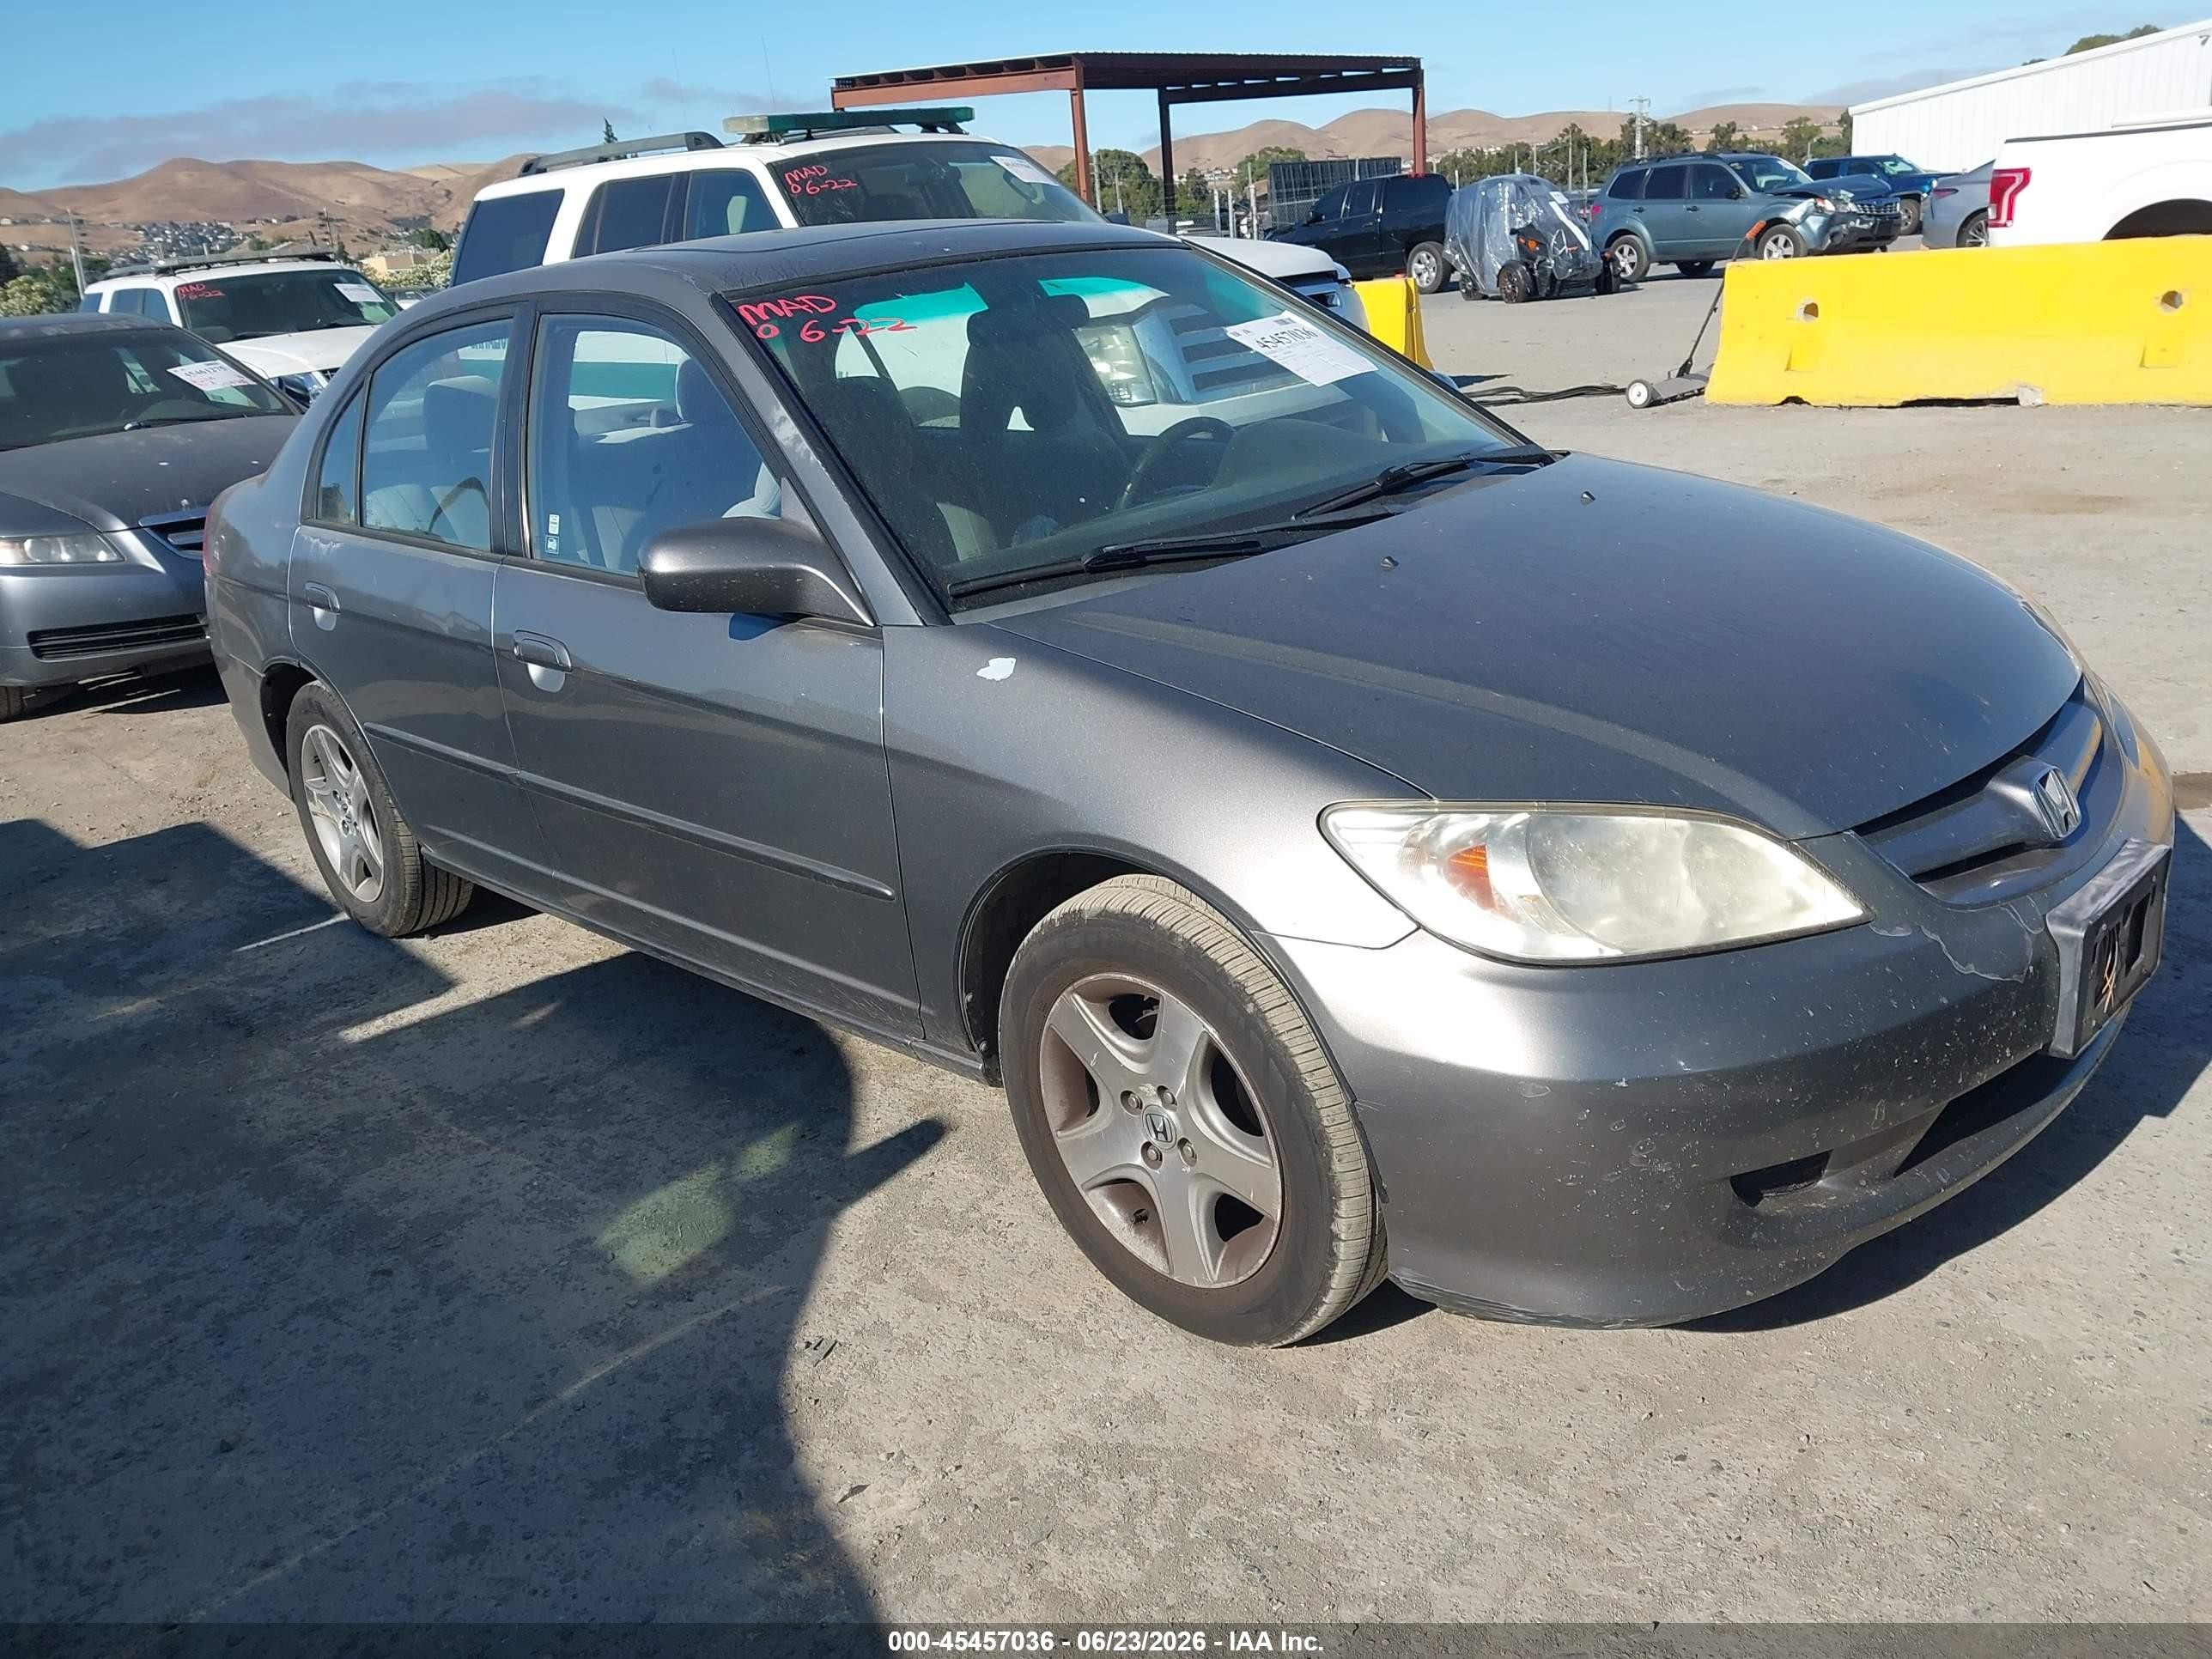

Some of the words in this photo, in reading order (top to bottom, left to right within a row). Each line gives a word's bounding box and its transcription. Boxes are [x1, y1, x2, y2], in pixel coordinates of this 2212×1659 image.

[784, 165, 828, 185] MAD
[177, 283, 206, 294] MAD
[738, 295, 837, 325] MAD
[1255, 326, 1319, 350] 45457036
